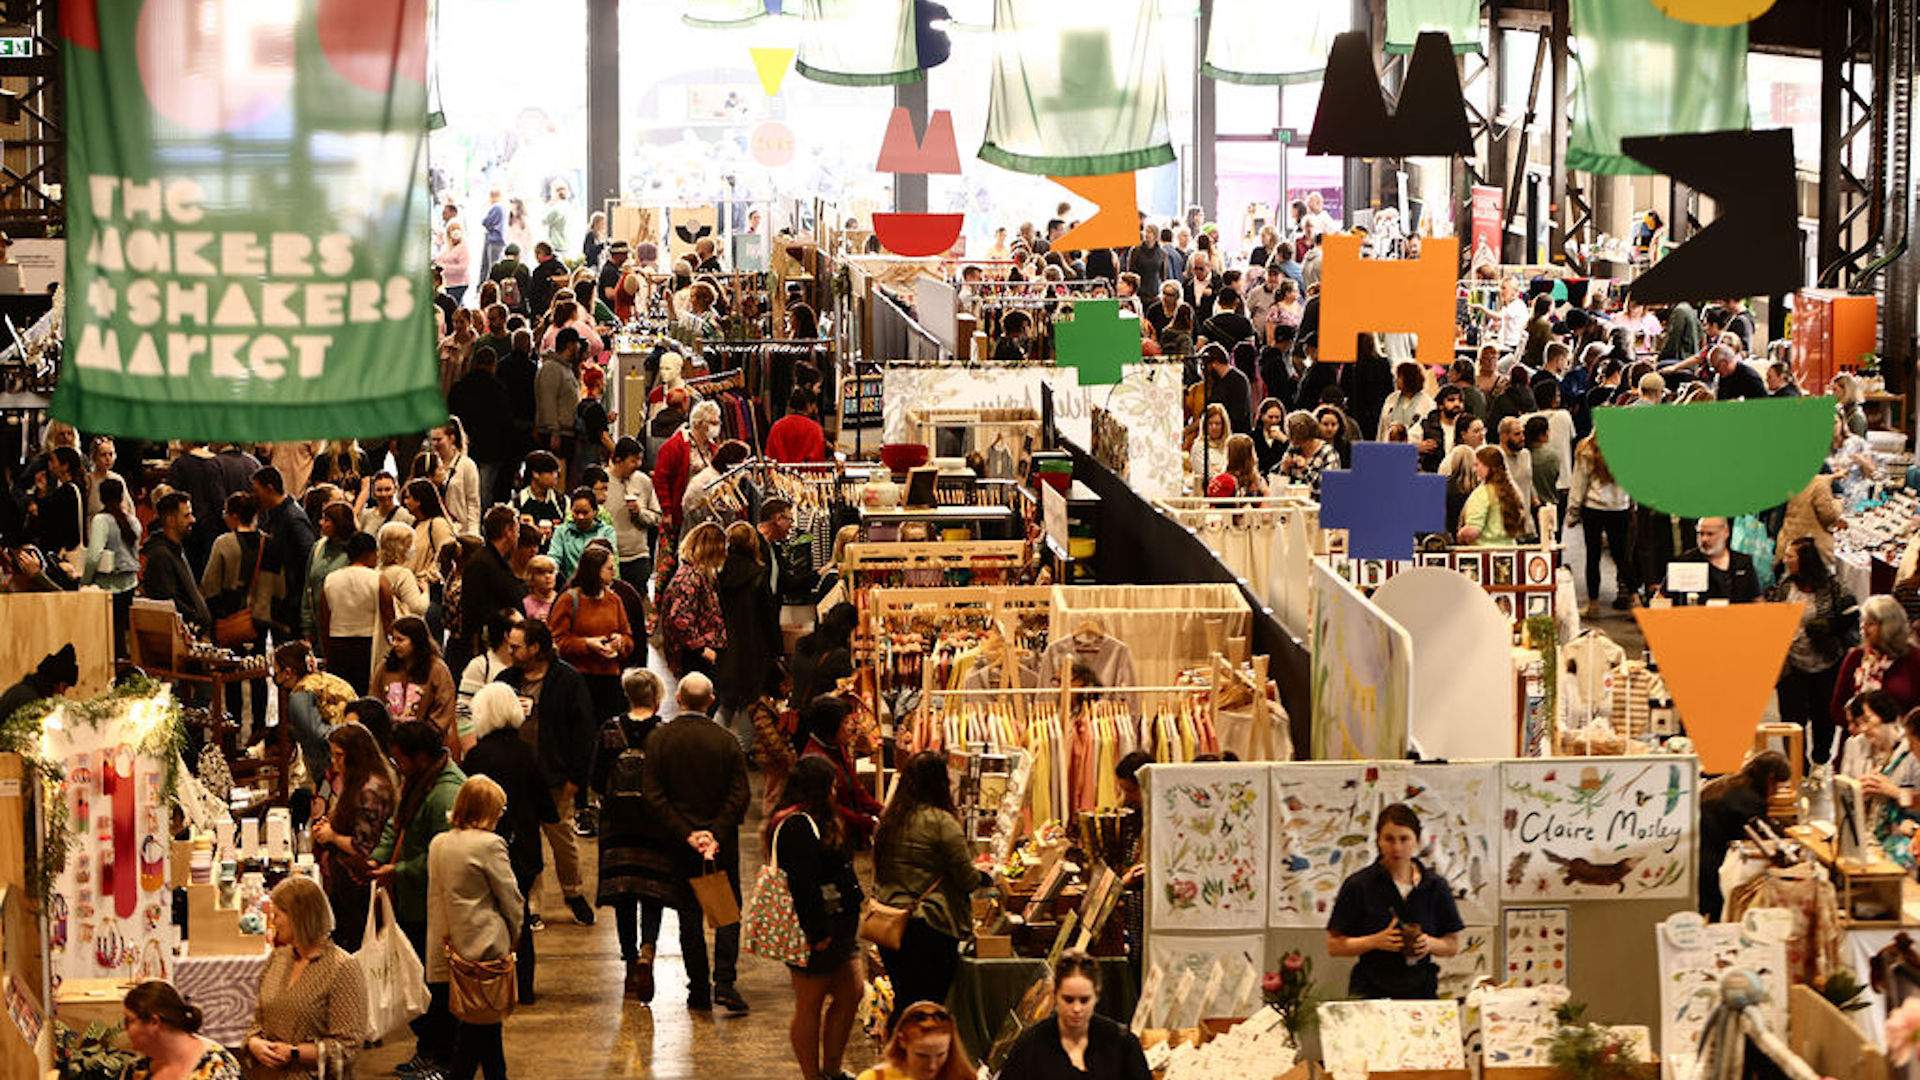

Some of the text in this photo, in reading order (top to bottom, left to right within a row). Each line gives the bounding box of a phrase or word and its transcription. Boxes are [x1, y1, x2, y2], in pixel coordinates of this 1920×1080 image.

[126, 275, 415, 327] SHAKERS
[1520, 810, 1682, 853] Claire Mosley
